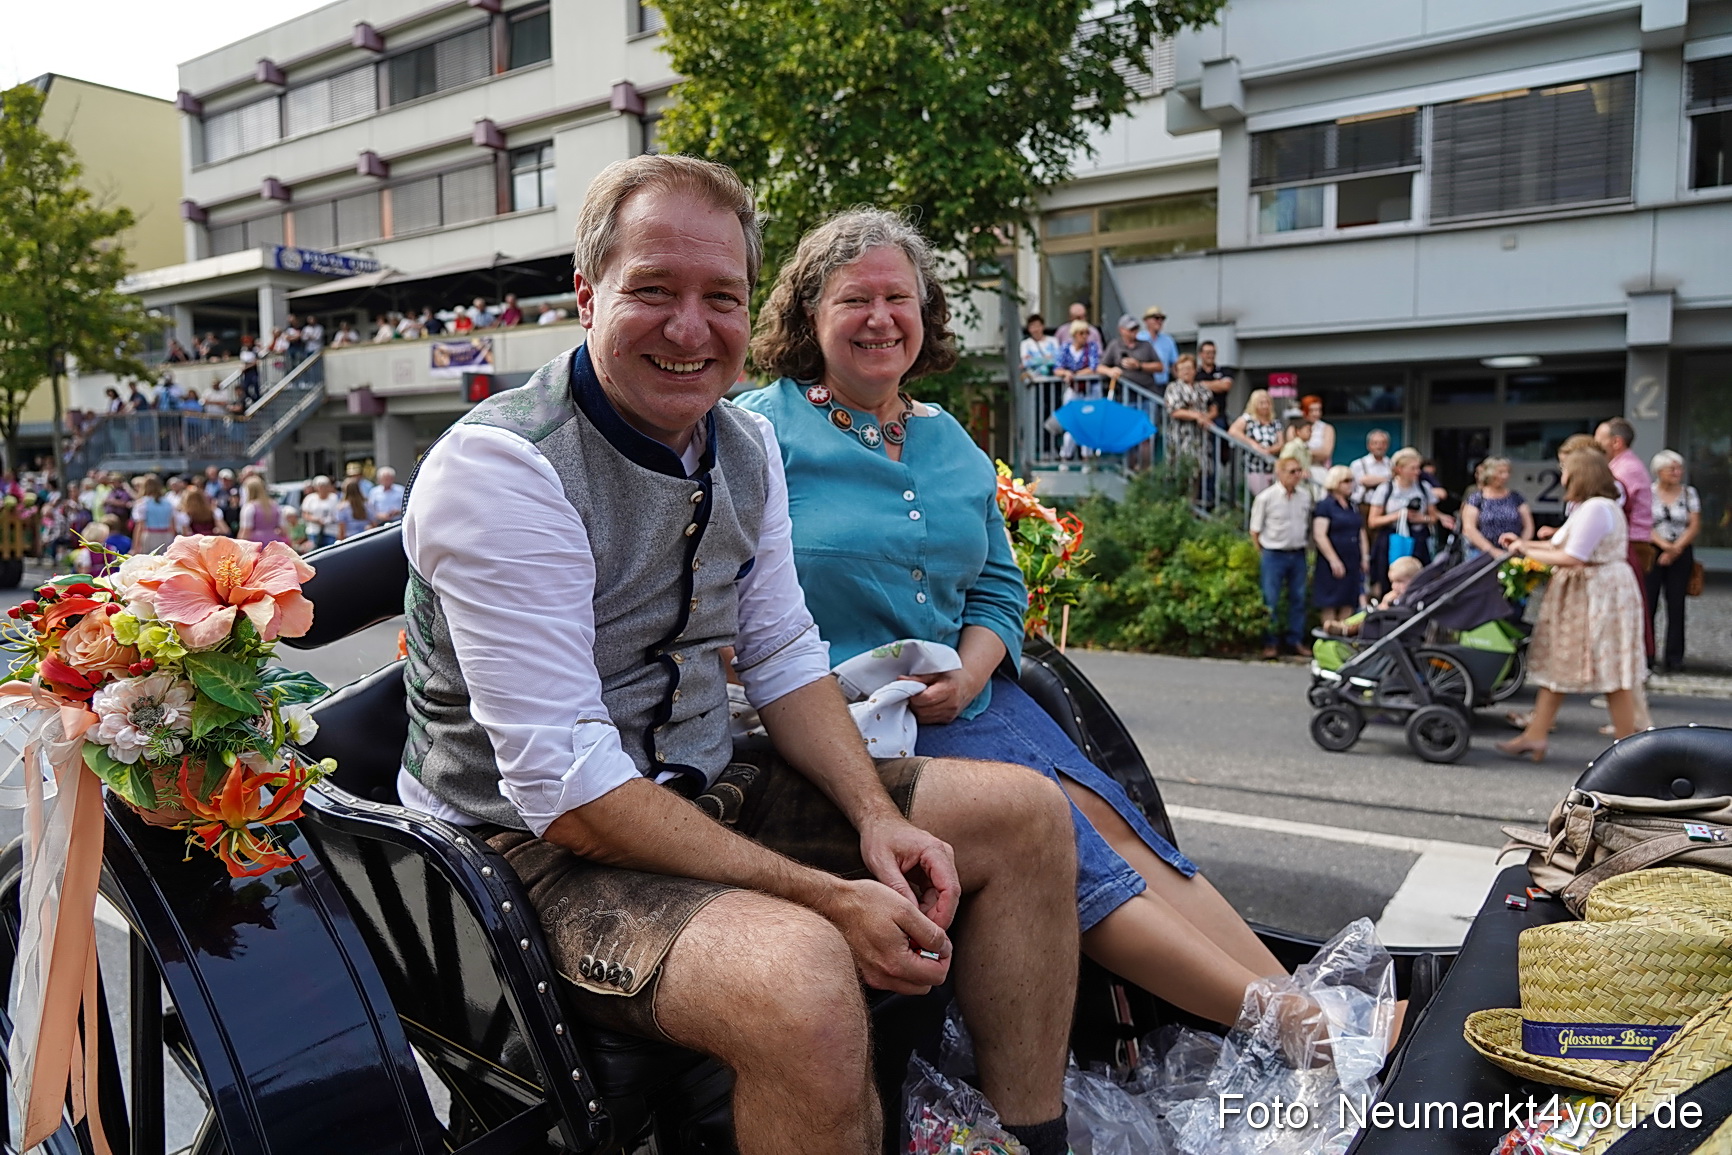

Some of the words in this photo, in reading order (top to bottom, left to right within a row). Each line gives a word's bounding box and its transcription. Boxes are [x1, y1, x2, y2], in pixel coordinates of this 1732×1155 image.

[1633, 375, 1660, 419] 2
[1537, 469, 1561, 503] 2
[1558, 1029, 1658, 1055] Glossner-Bier
